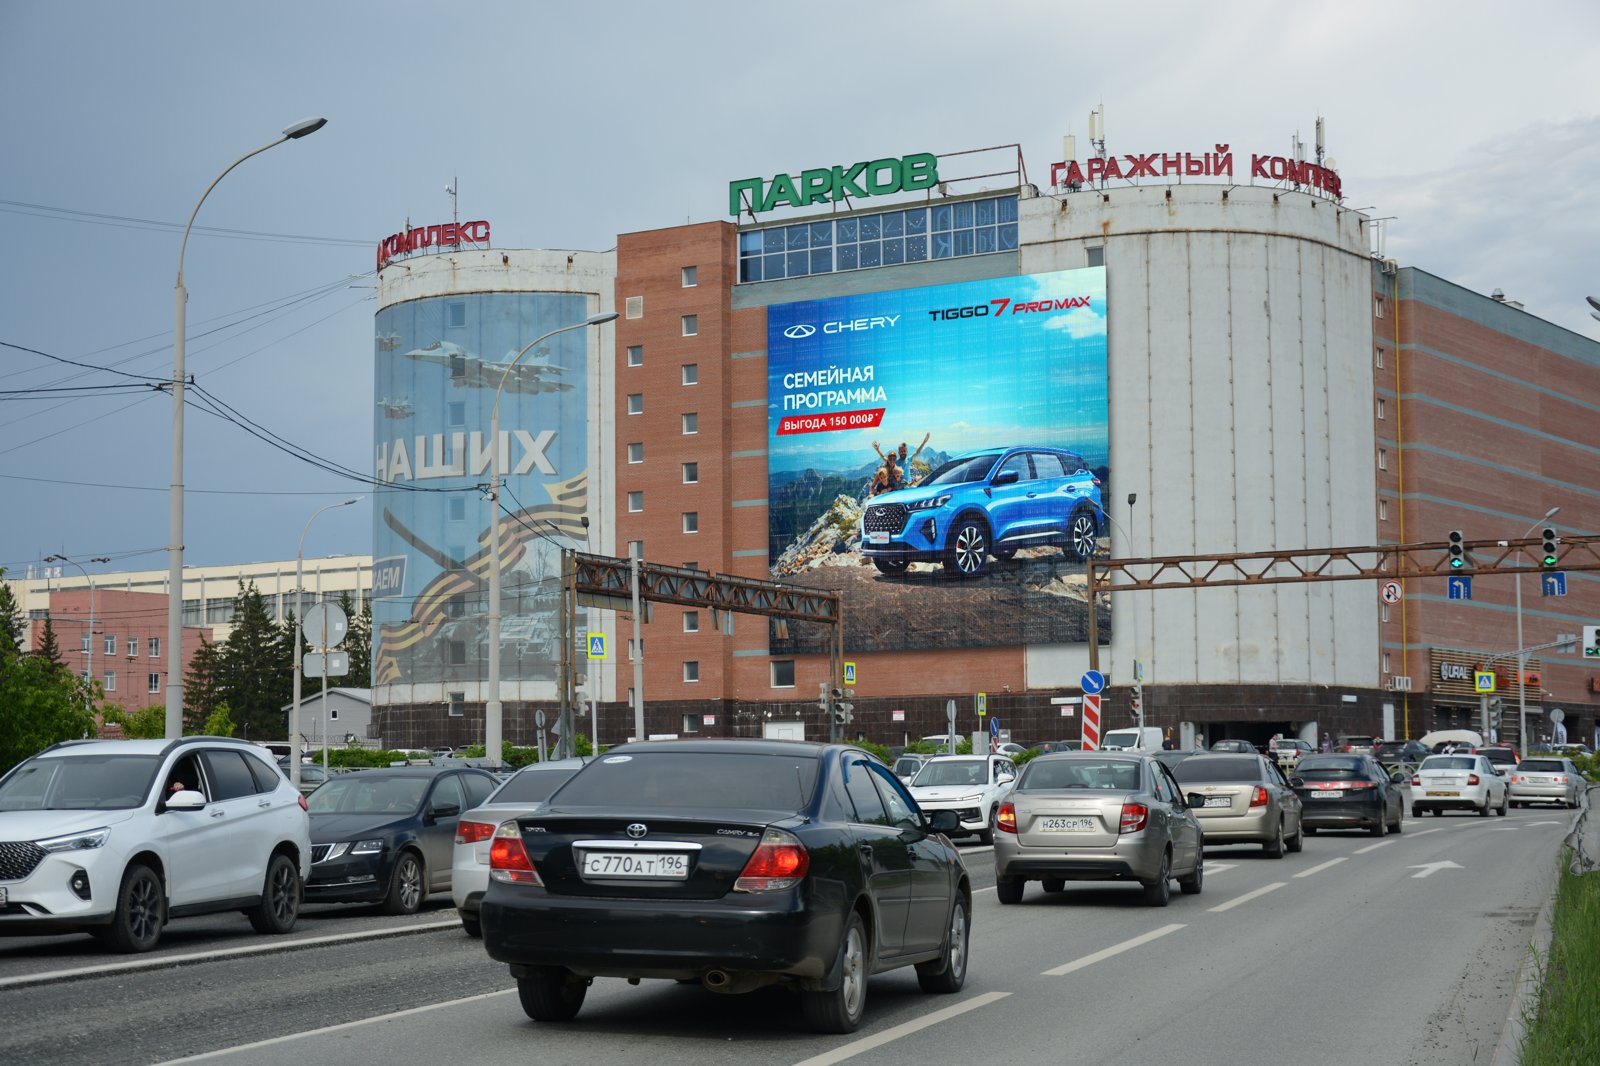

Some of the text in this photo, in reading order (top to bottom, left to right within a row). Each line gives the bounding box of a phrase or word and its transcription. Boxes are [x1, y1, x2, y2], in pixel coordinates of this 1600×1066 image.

[1051, 144, 1233, 186] ГАРАЖНЫЙ
[729, 153, 938, 216] ПАРКОВ
[382, 220, 490, 262] КОМПЛЕКС
[929, 305, 989, 321] TIGGO
[990, 298, 1011, 317] 7
[823, 315, 900, 334] CHERY
[783, 365, 874, 389] СЕМЕЙНАЯ
[783, 386, 887, 410] ПРОГРАММА
[784, 418, 827, 430] ВЫГОДА
[829, 416, 847, 426] 150
[376, 430, 559, 487] НАШИХ
[659, 856, 683, 869] 196
